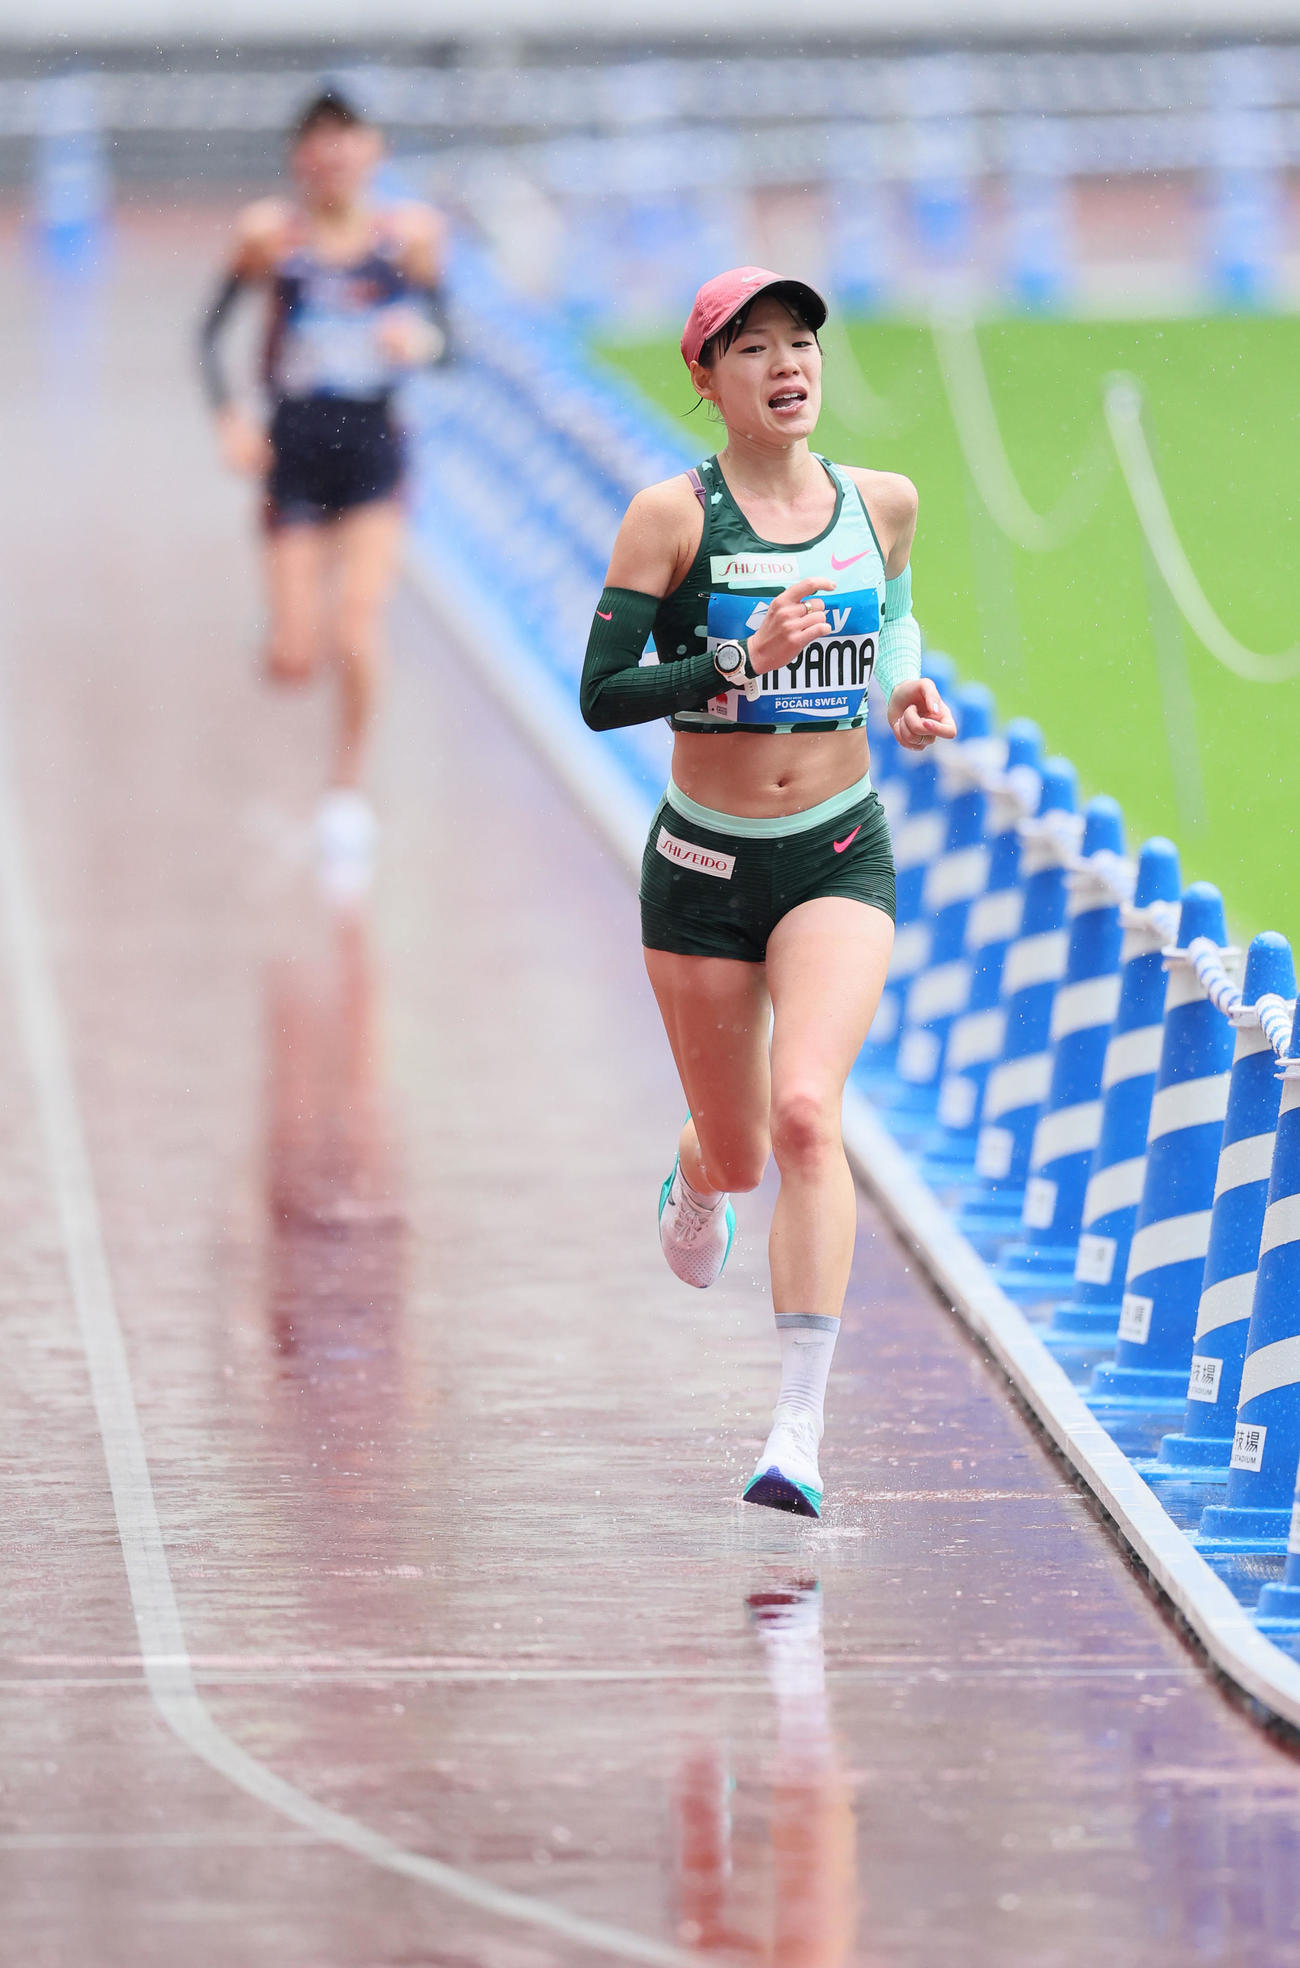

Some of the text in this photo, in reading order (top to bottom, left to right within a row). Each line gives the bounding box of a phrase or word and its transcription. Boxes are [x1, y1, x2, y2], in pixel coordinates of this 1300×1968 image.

[718, 561, 793, 577] SHISEIDO
[775, 699, 813, 709] POCARI
[815, 696, 848, 707] SWEAT
[661, 840, 728, 872] SHISEIDO
